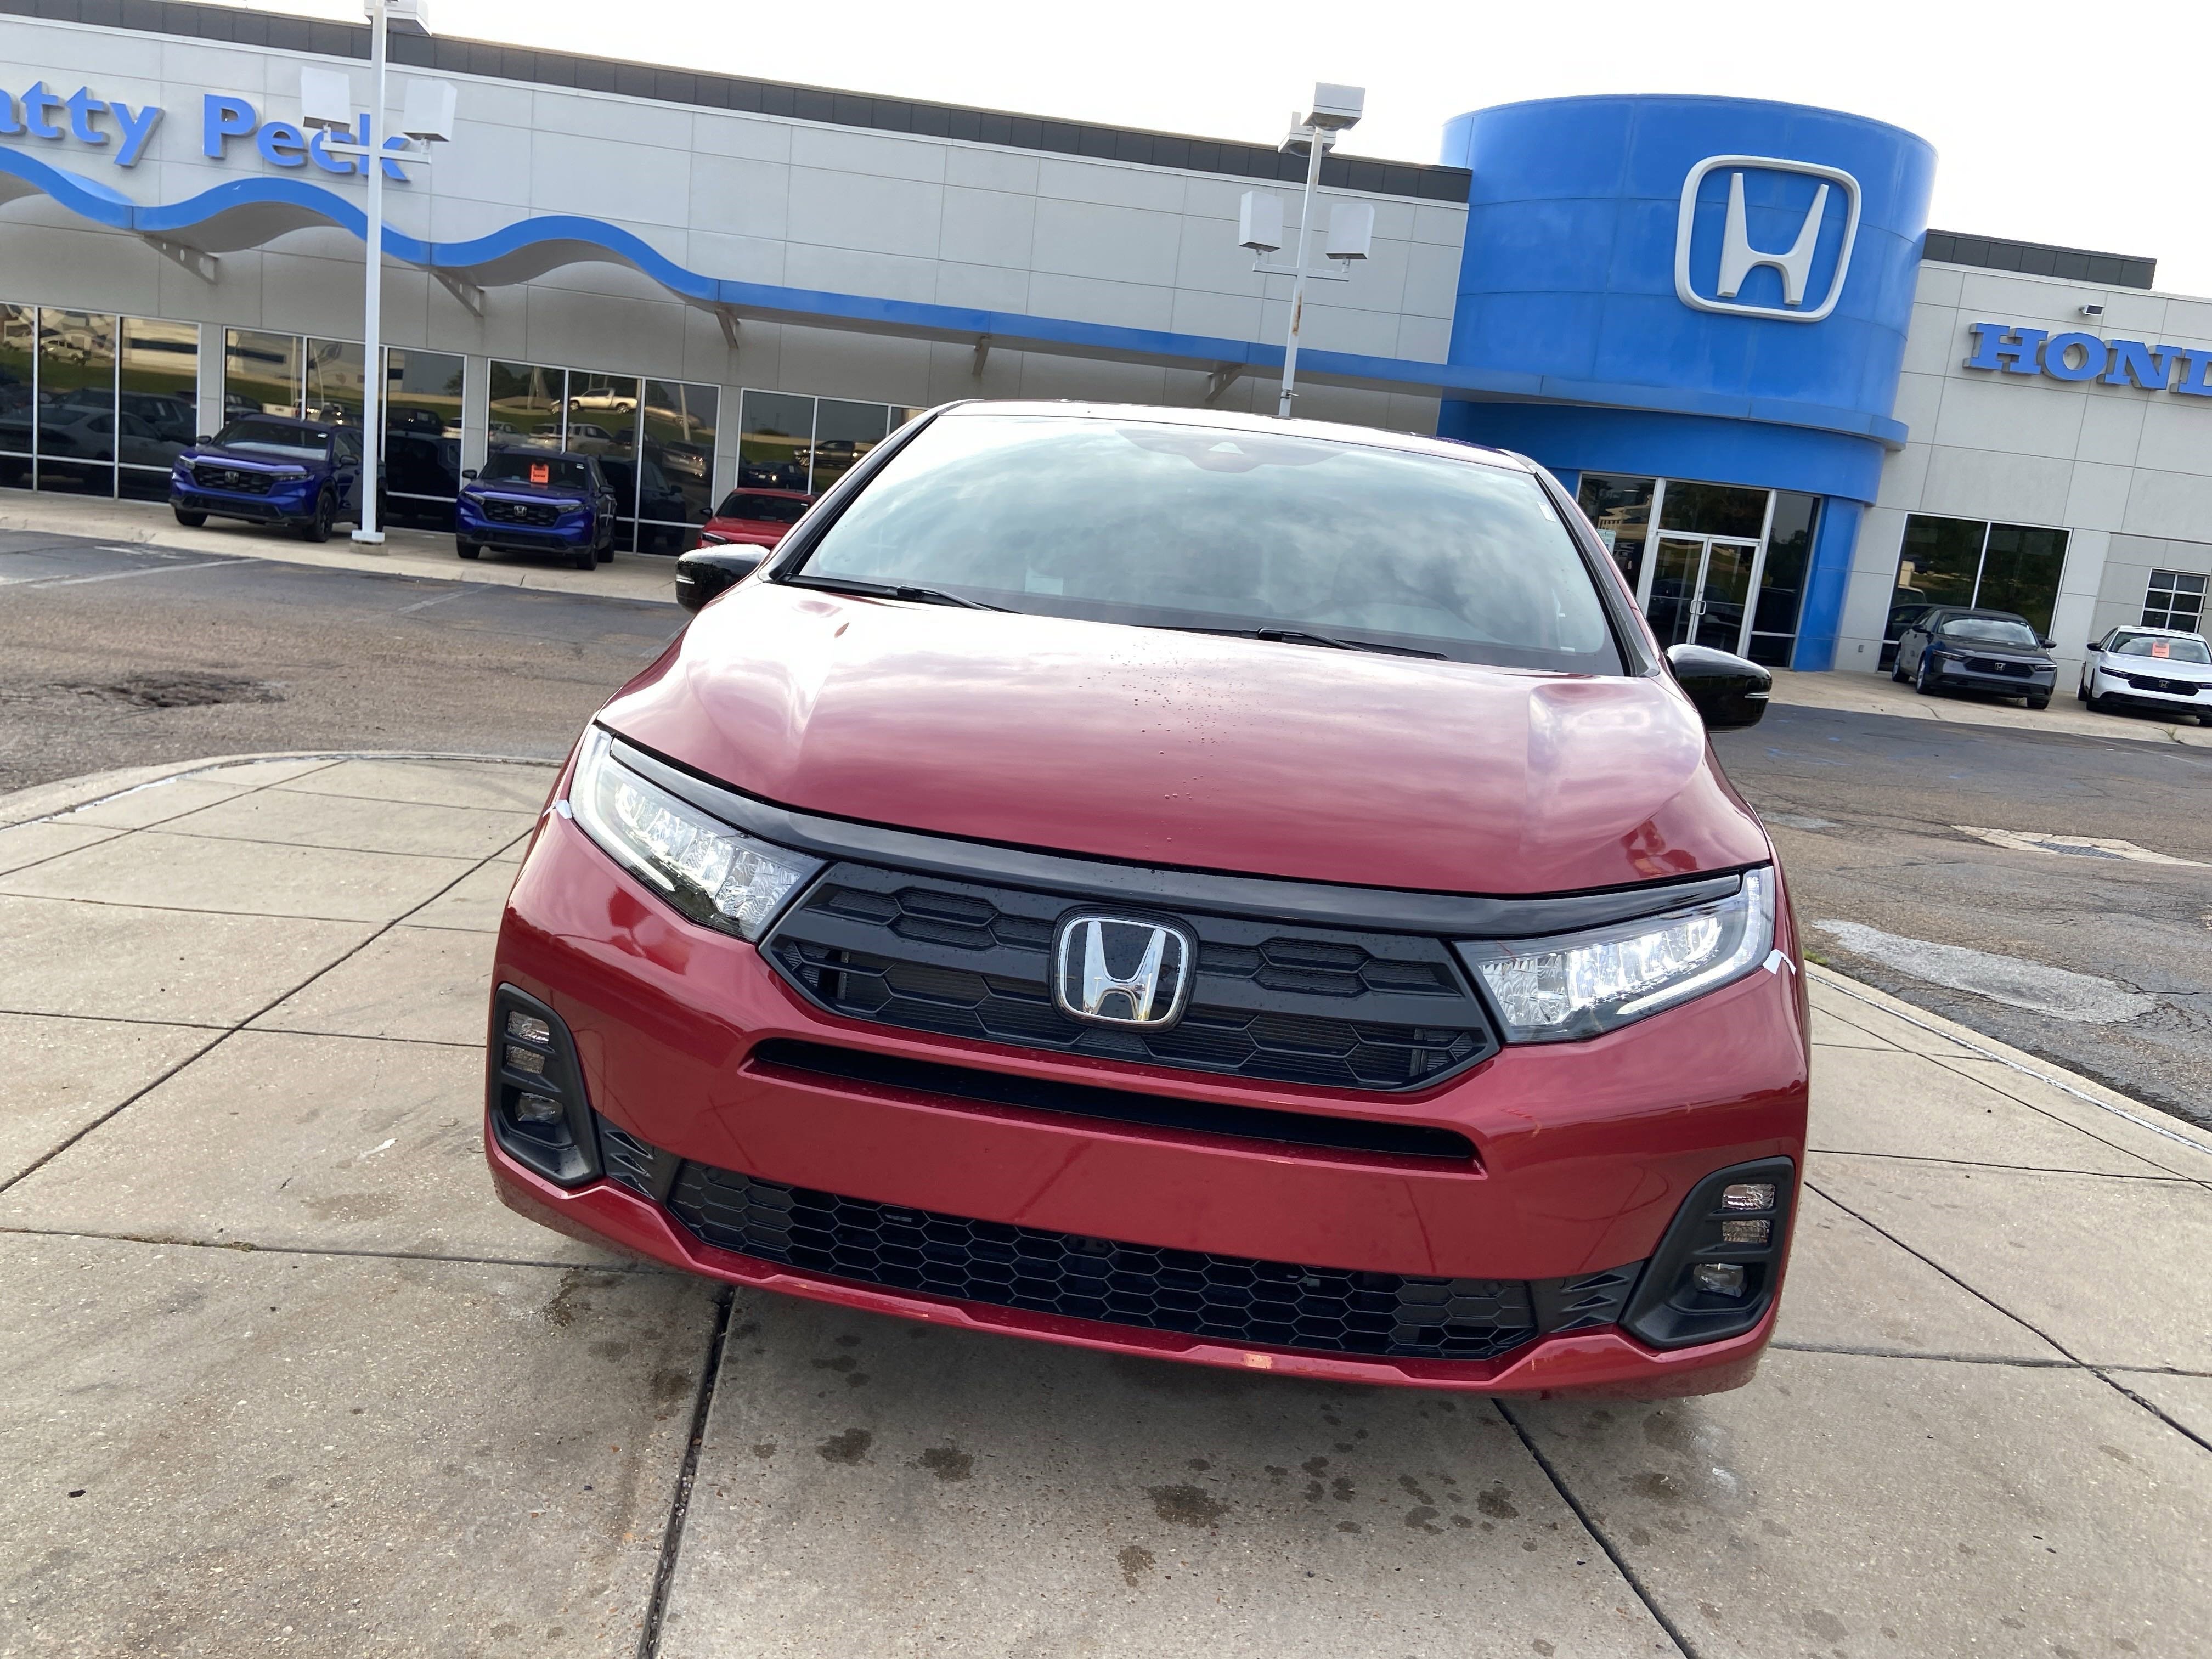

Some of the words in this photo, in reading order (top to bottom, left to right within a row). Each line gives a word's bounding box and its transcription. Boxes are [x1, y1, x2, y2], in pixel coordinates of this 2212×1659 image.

[204, 94, 410, 180] Peck
[1717, 172, 1829, 305] H
[1082, 921, 1166, 1021] H
